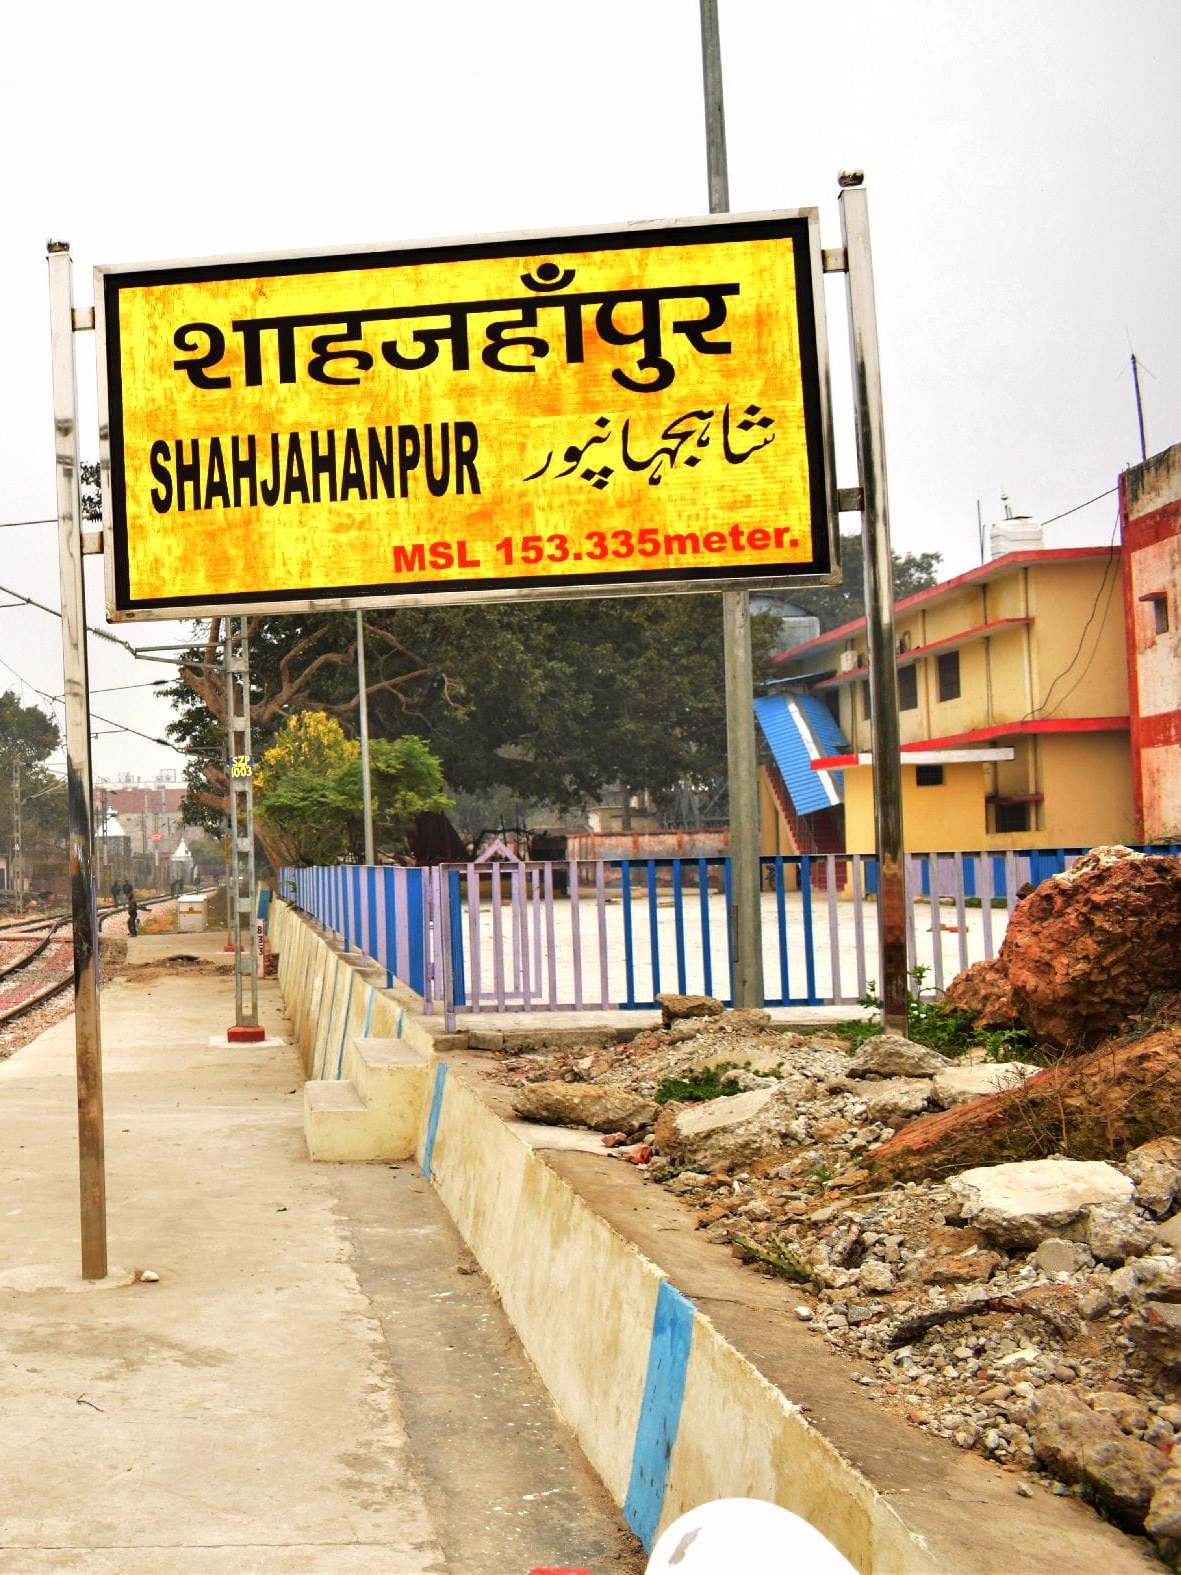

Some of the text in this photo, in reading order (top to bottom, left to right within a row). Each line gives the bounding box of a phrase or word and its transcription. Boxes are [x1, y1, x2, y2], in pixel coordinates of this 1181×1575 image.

[173, 262, 740, 393] शाहजहाँपुर
[150, 421, 481, 514] SHAHJAHANPUR
[393, 524, 799, 573] MSL 153.335meter.
